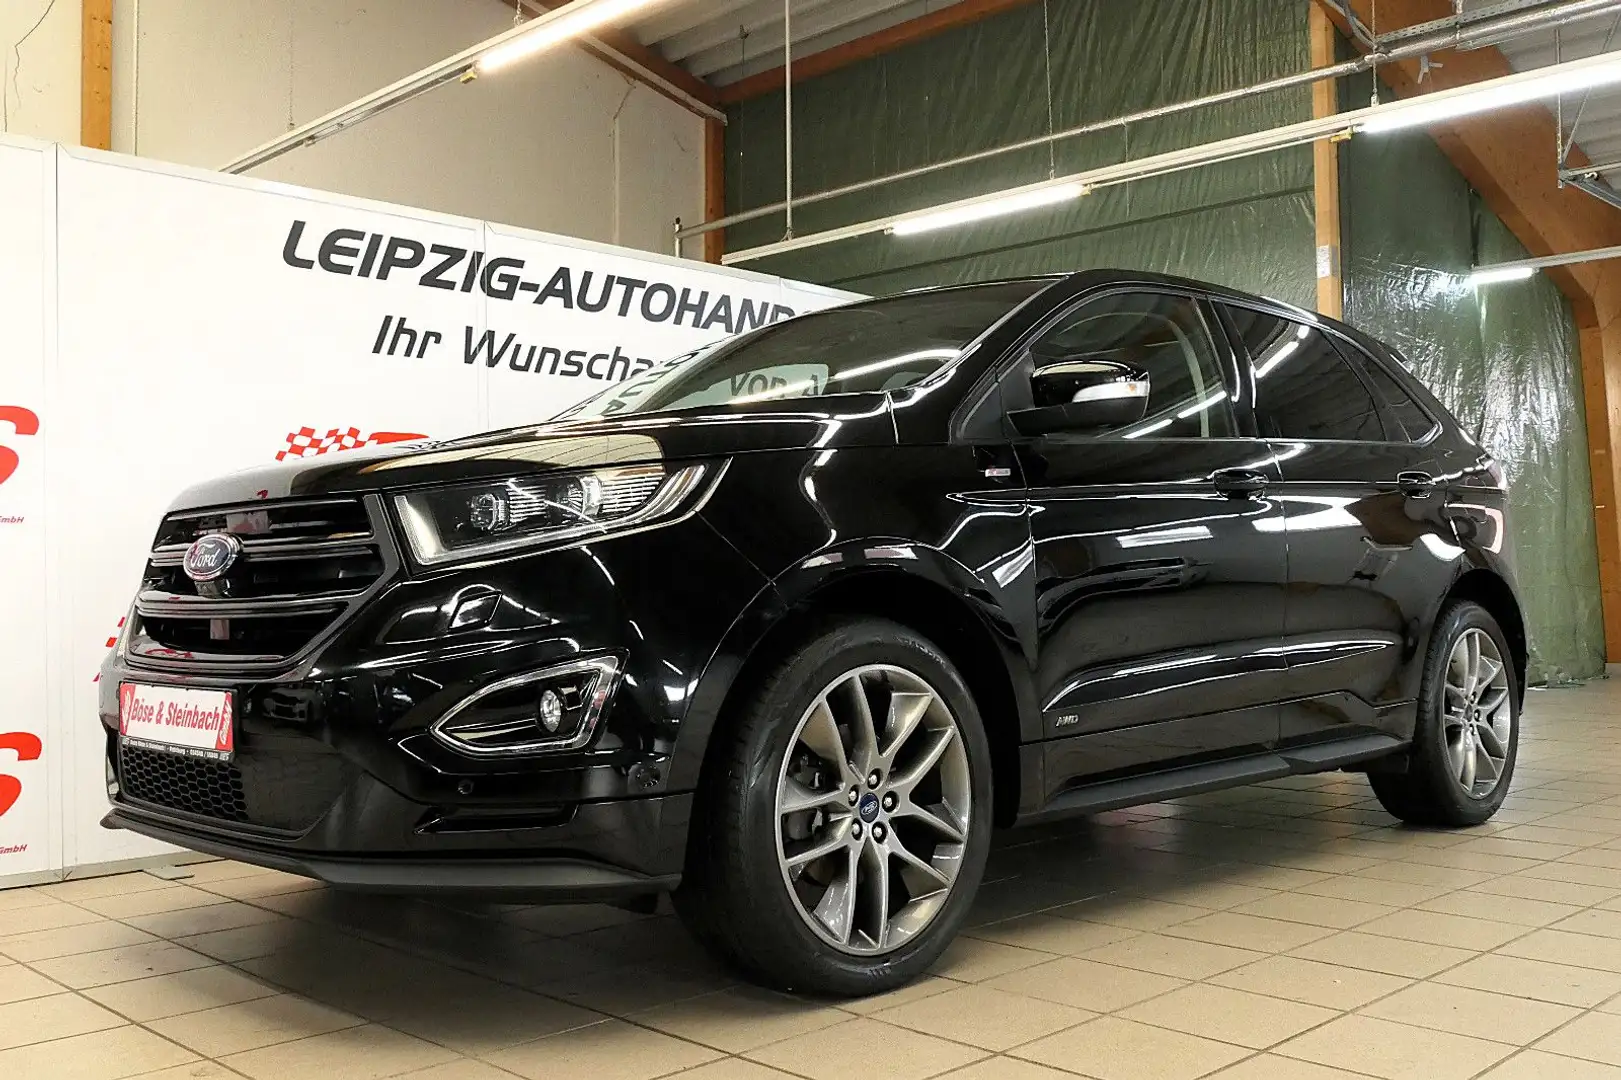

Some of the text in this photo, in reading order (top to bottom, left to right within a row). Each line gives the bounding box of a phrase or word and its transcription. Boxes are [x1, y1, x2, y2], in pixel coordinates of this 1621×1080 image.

[373, 315, 442, 359] Ihr
[0, 515, 25, 524] mbH
[190, 543, 220, 567] Ford
[131, 698, 154, 723] Böse
[156, 700, 165, 725] &
[166, 701, 220, 731] Steinbach
[1055, 714, 1079, 727] AWD
